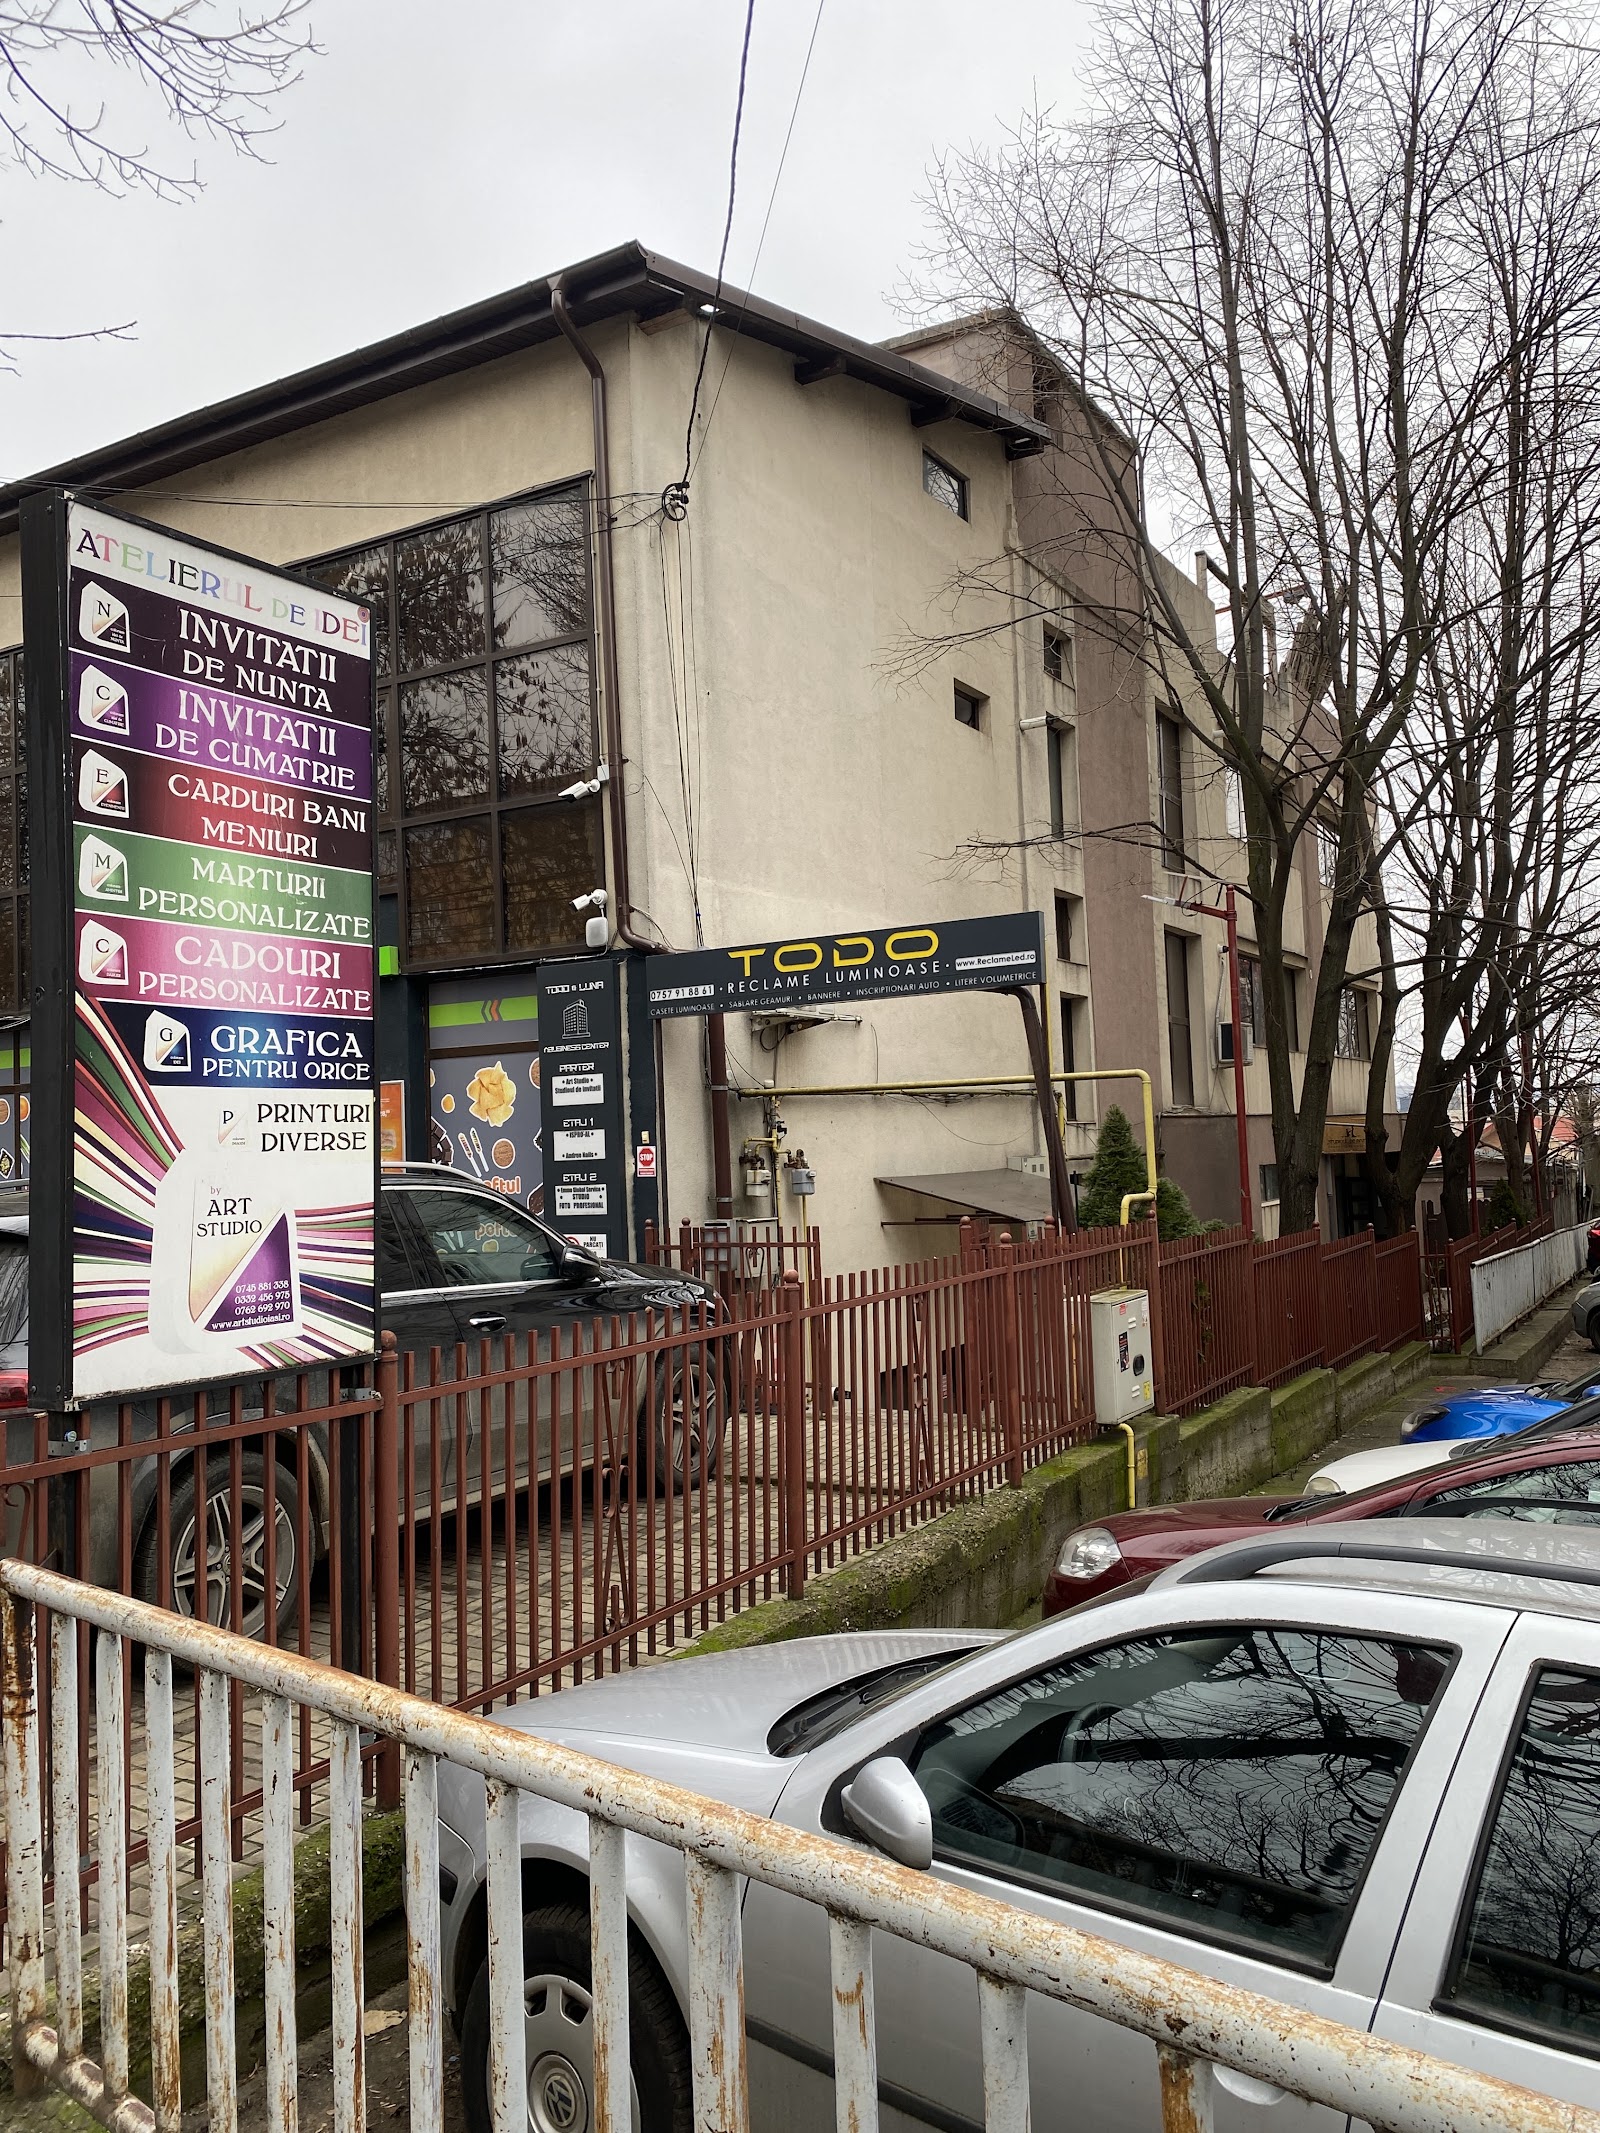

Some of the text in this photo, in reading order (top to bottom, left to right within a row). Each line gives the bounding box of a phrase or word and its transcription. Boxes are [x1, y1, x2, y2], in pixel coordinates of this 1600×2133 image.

[76, 528, 367, 646] ATELIERUL DE IDEI
[179, 608, 337, 683] INVITATII
[183, 649, 333, 713] DE NUNTA
[178, 689, 337, 757] INVITATII
[155, 723, 356, 792] DE CUMATRIE
[168, 774, 367, 833] CARDURI BANI
[201, 817, 317, 859] MENIURI
[190, 857, 326, 899] MARTURII
[138, 886, 371, 939] PERSONALIZATE
[174, 936, 341, 980] CADOURI
[728, 929, 939, 977] TODO
[956, 953, 1035, 968] www.ReclameLed.ro
[579, 981, 604, 991] LUNA
[727, 960, 940, 994] RECLAME LUMINOASE
[138, 971, 371, 1012] PERSONALIZATE
[650, 986, 713, 1000] 0757 91 88 61
[650, 972, 1037, 1016] CASETE LUMINOASE SABLARE GEAMURI BANNERE INSCRIPTIONARI AUTO LITERE VOLUMETRICE
[210, 1025, 363, 1058] GRAFICA
[202, 1057, 370, 1081] PENTRU ORICE
[559, 1062, 594, 1072] PARTER
[223, 1110, 234, 1124] P
[256, 1103, 370, 1123] PRINTURI
[563, 1117, 594, 1127] ETAJ 1
[261, 1131, 367, 1153] DIVERSE
[640, 1153, 653, 1161] STOP
[563, 1172, 597, 1182] ETAJ 2
[210, 1186, 221, 1196] by
[206, 1197, 252, 1217] ART
[196, 1219, 262, 1238] STUDIO
[234, 1291, 290, 1304] 0332 456 975
[235, 1280, 289, 1293] 0745 881 338
[234, 1301, 290, 1315] 0762 692 970
